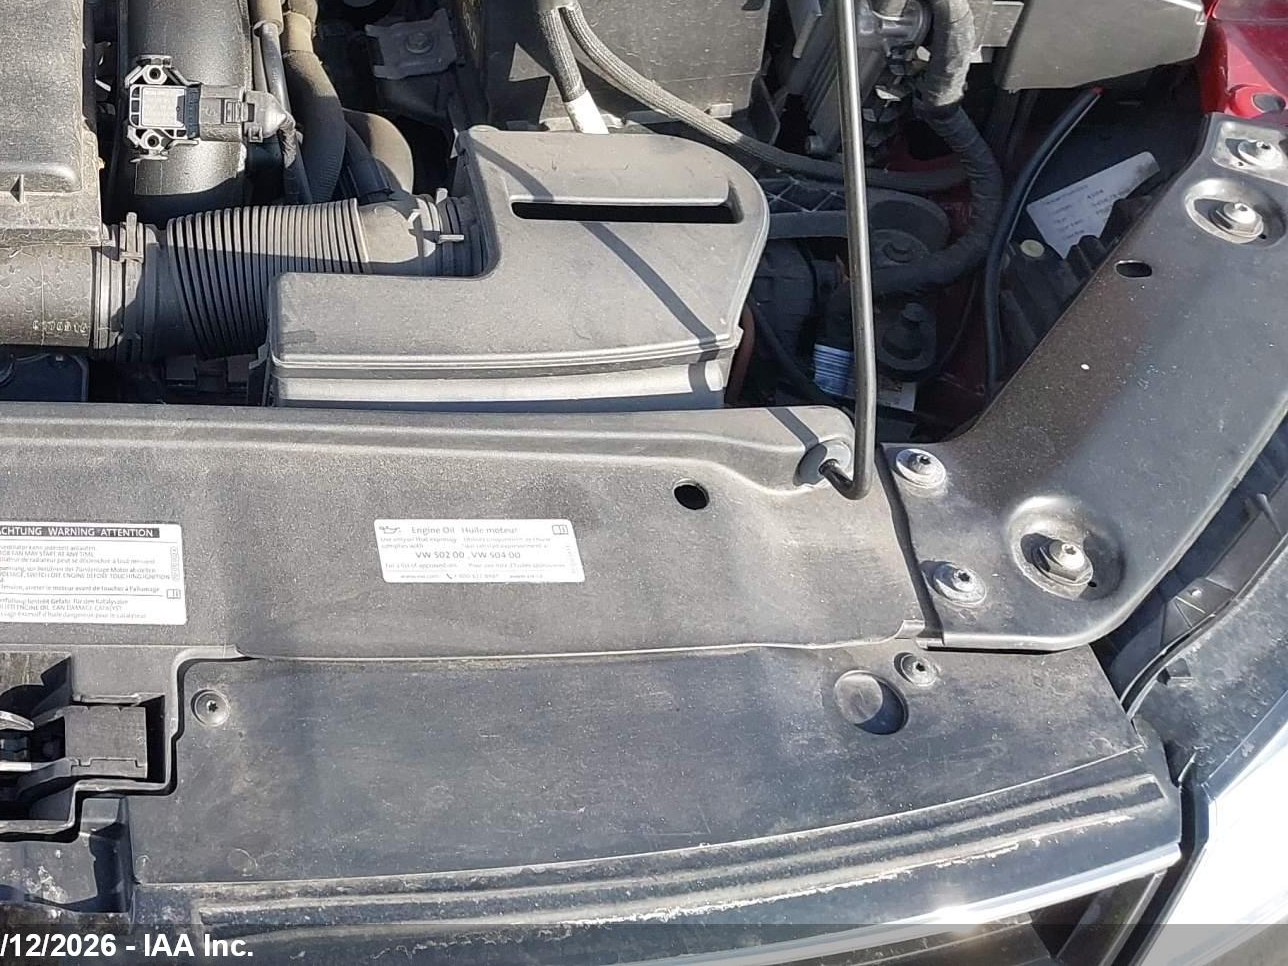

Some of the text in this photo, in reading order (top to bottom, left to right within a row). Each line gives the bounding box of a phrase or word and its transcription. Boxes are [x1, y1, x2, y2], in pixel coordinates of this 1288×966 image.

[48, 527, 96, 536] WARNING
[100, 528, 154, 537] ATTENTION
[411, 525, 441, 538] Engine
[442, 525, 455, 535] Oil
[486, 525, 518, 535] moteur
[415, 551, 521, 559] VW 502 00 VW 504 00
